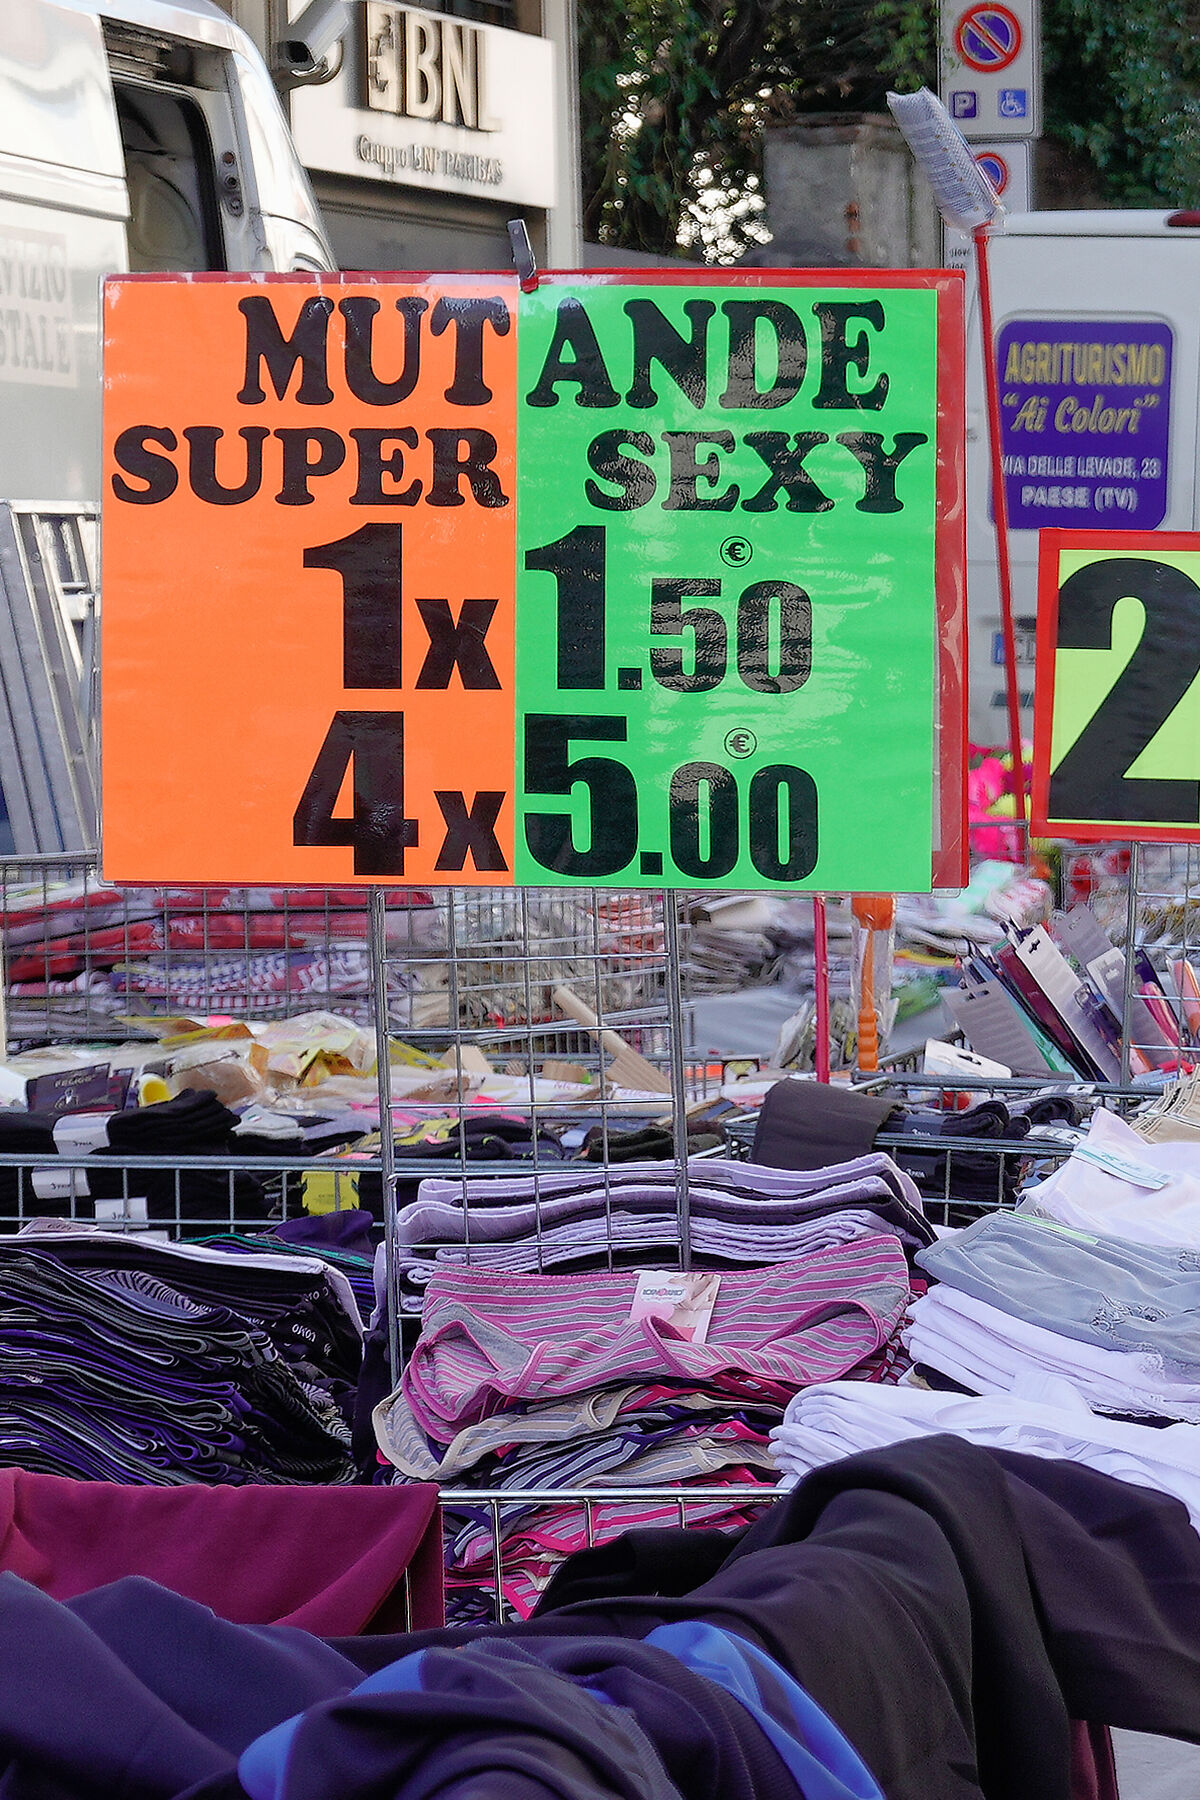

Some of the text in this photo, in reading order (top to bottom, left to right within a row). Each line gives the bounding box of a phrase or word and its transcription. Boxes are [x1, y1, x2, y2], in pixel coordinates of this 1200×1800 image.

[404, 11, 501, 132] BNL
[359, 134, 408, 173] Gruppo
[412, 144, 442, 176] BNP
[1004, 342, 1165, 386] AGRITURISMO
[112, 425, 929, 514] SUPER SEXY
[1021, 486, 1139, 511] PAESE (TV)
[1027, 454, 1075, 477] DELLE
[524, 524, 813, 695] 1.50
[523, 712, 819, 883] 5.00
